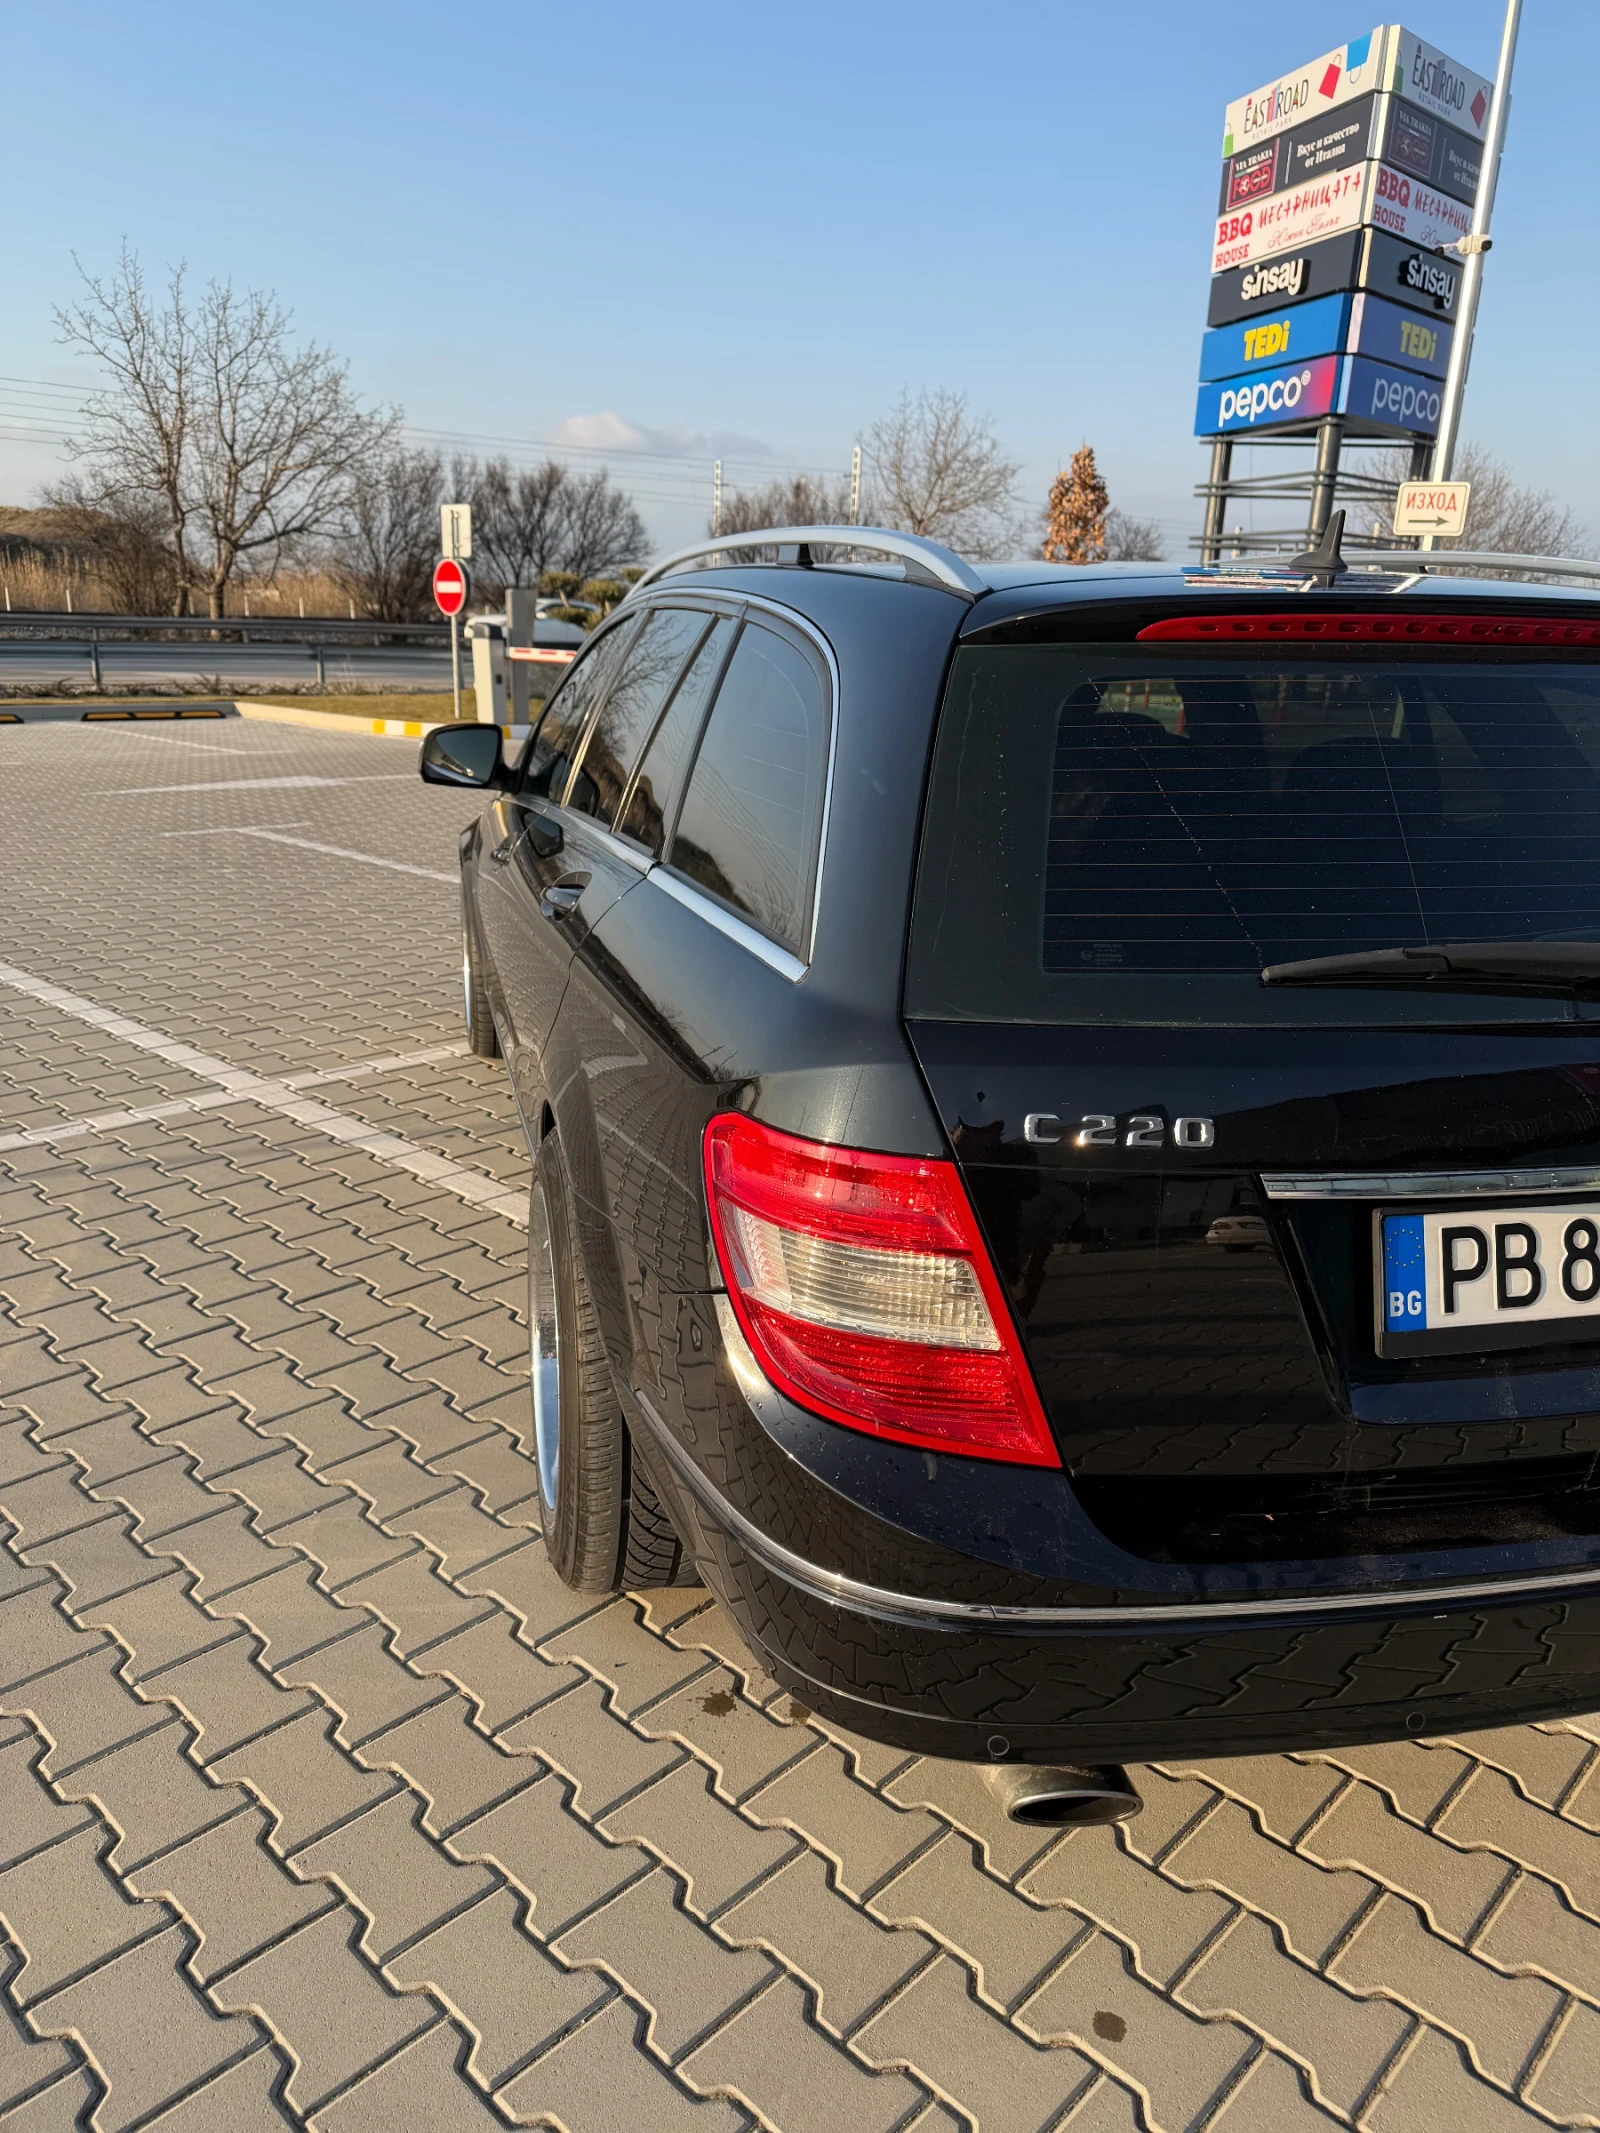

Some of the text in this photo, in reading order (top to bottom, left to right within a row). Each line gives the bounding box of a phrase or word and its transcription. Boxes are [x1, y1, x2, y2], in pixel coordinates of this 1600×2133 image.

[1399, 110, 1432, 137] VIA TRAKIA
[1437, 103, 1451, 117] PARK
[1252, 116, 1292, 140] RETAIL PARK
[1297, 123, 1360, 158] Вкус и качество
[1235, 149, 1273, 172] VIA TRAKIA
[1305, 144, 1346, 168] от Италия
[1258, 171, 1361, 228] МЕСАРНИЦАТА
[1376, 168, 1411, 209] BBQ
[1217, 212, 1253, 246] BBQ
[1373, 203, 1406, 233] HOUSE
[1215, 243, 1250, 268] HOUSE
[1240, 257, 1304, 300] sinsay
[1407, 253, 1456, 309] sinsay
[1243, 320, 1290, 361] TEDi
[1400, 321, 1438, 362] TEDi
[1218, 375, 1302, 428] pepco
[1371, 377, 1441, 423] pepco
[1406, 492, 1457, 512] ИЗХОД
[1023, 1112, 1216, 1149] C 220
[1440, 1221, 1542, 1316] PB
[1389, 1290, 1422, 1318] BG
